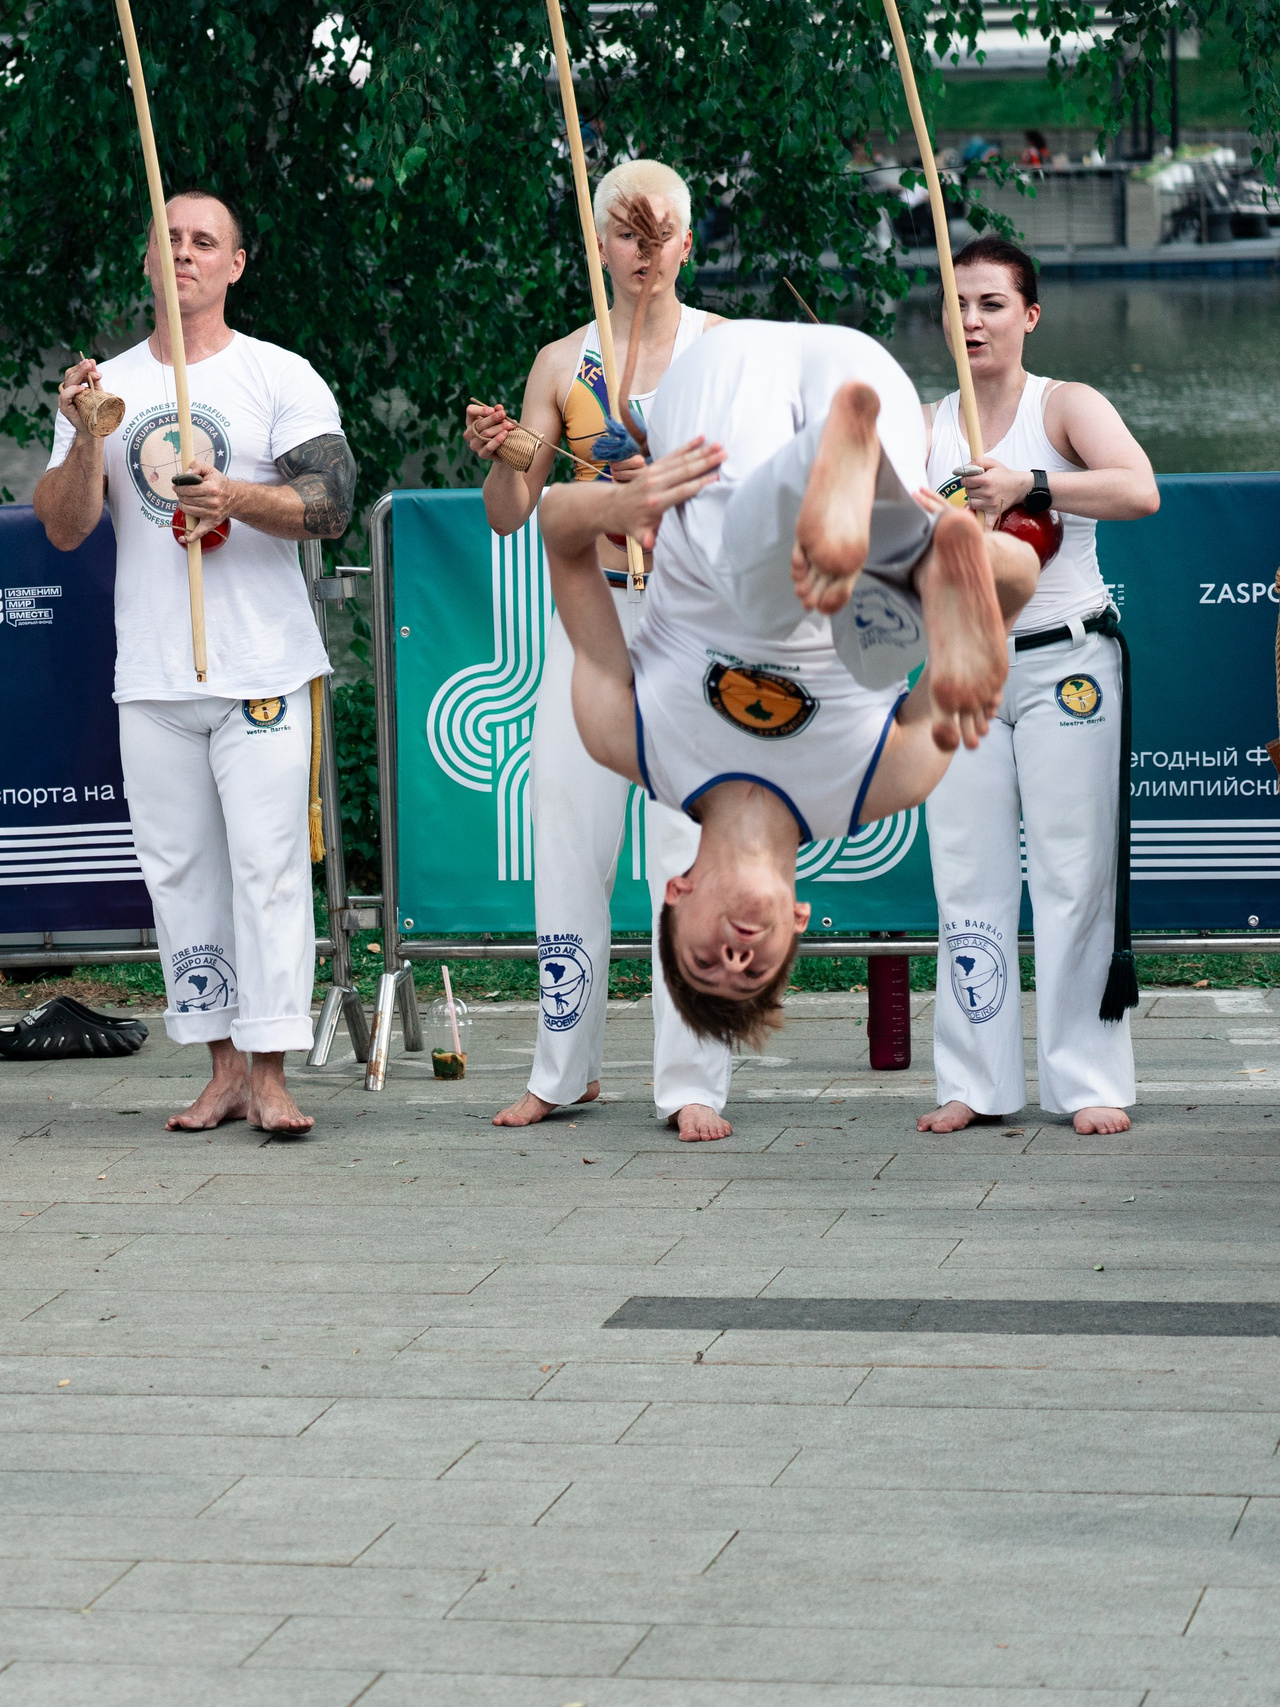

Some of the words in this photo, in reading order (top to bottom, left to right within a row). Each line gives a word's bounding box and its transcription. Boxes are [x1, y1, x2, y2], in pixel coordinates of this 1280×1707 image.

[122, 402, 177, 441] CONTRAMEST
[191, 401, 231, 428] PARAFUSO
[133, 423, 156, 450] GRUPO
[158, 414, 177, 425] AXÉ
[192, 416, 219, 439] POEIRA
[146, 490, 177, 510] MESTRE
[140, 506, 173, 526] PROFESS
[8, 588, 59, 597] ИЗМЕНИМ
[9, 611, 50, 619] ВМЕСТЕ
[84, 784, 116, 801] на
[965, 919, 1003, 941] BARRÃO
[192, 944, 224, 955] BARRÃO
[174, 957, 201, 978] GRUPO
[203, 957, 218, 967] AXÉ
[543, 1011, 580, 1028] CAPOEIRA
